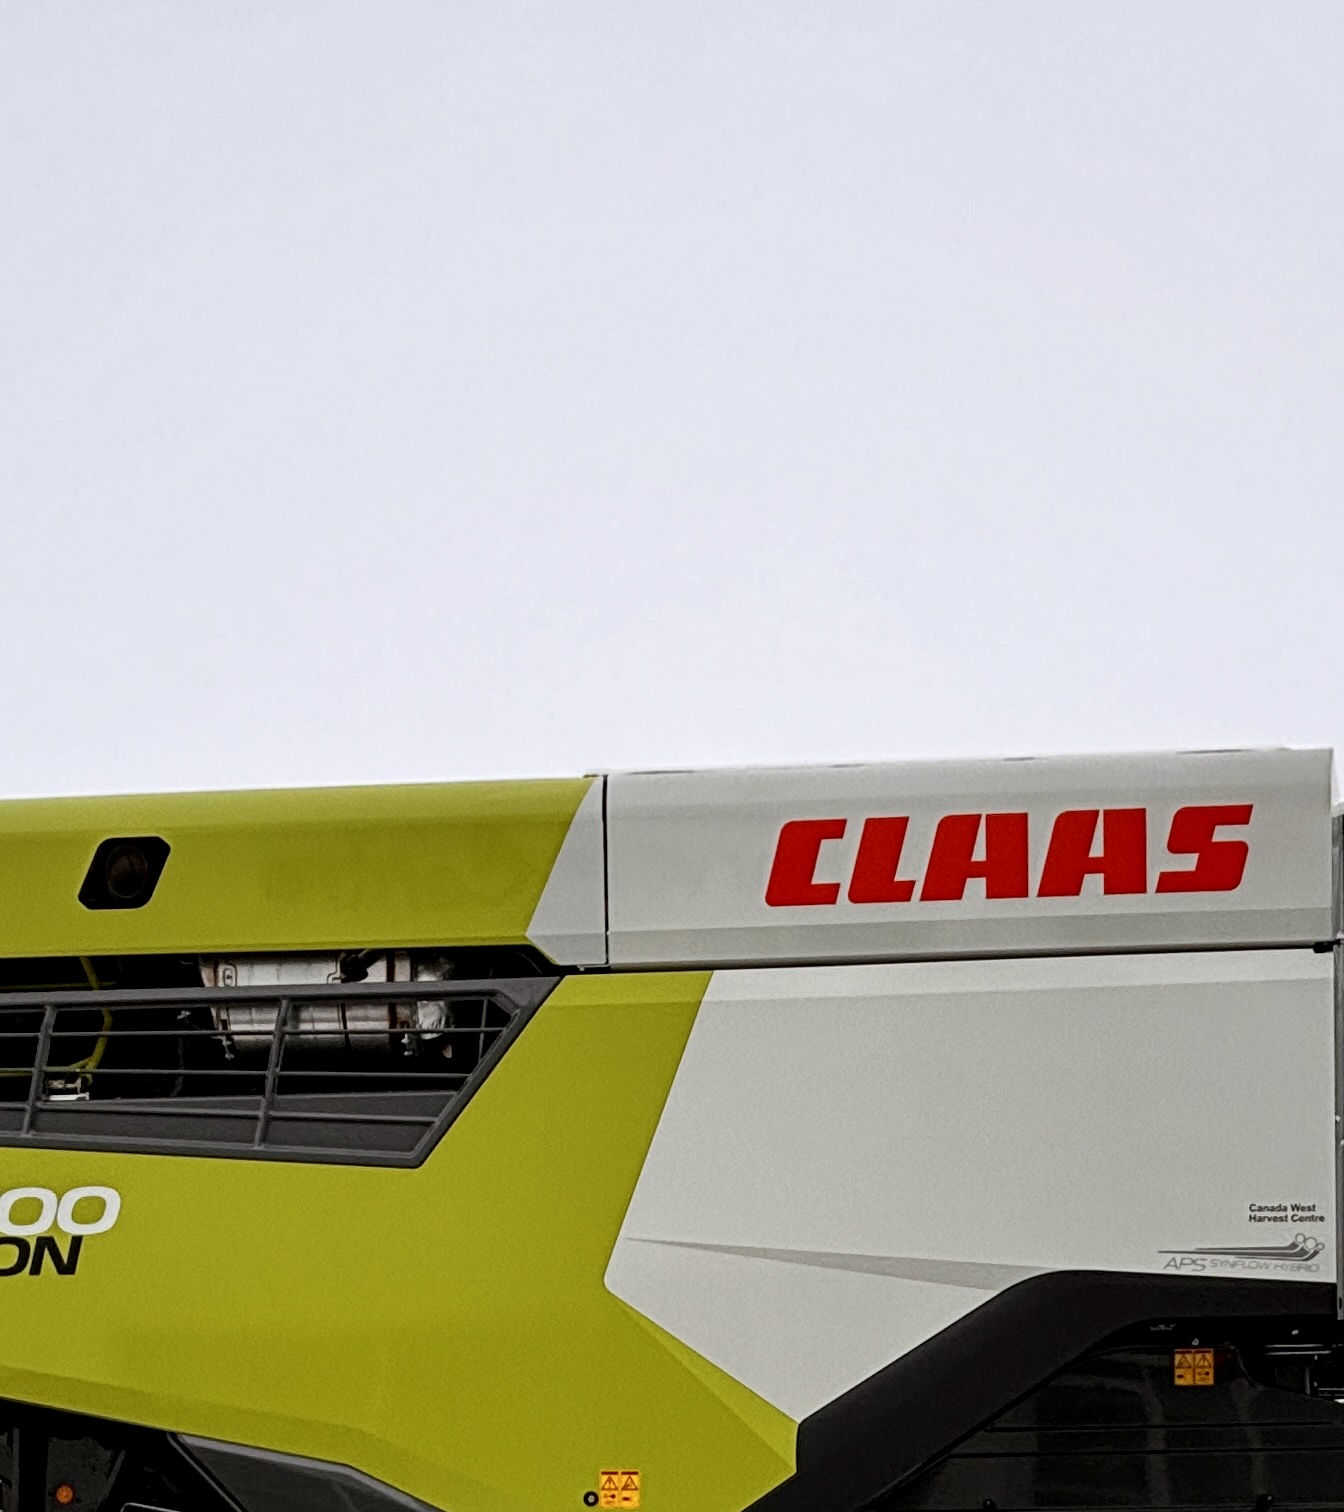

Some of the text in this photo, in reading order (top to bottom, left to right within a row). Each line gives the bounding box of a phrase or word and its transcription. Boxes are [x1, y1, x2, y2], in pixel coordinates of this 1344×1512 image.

[765, 804, 1254, 907] CLAAS
[1248, 1203, 1317, 1213] Canada West
[1248, 1214, 1325, 1223] Harvest Centre
[1163, 1256, 1320, 1273] APS SYNFLOW HYBRID
